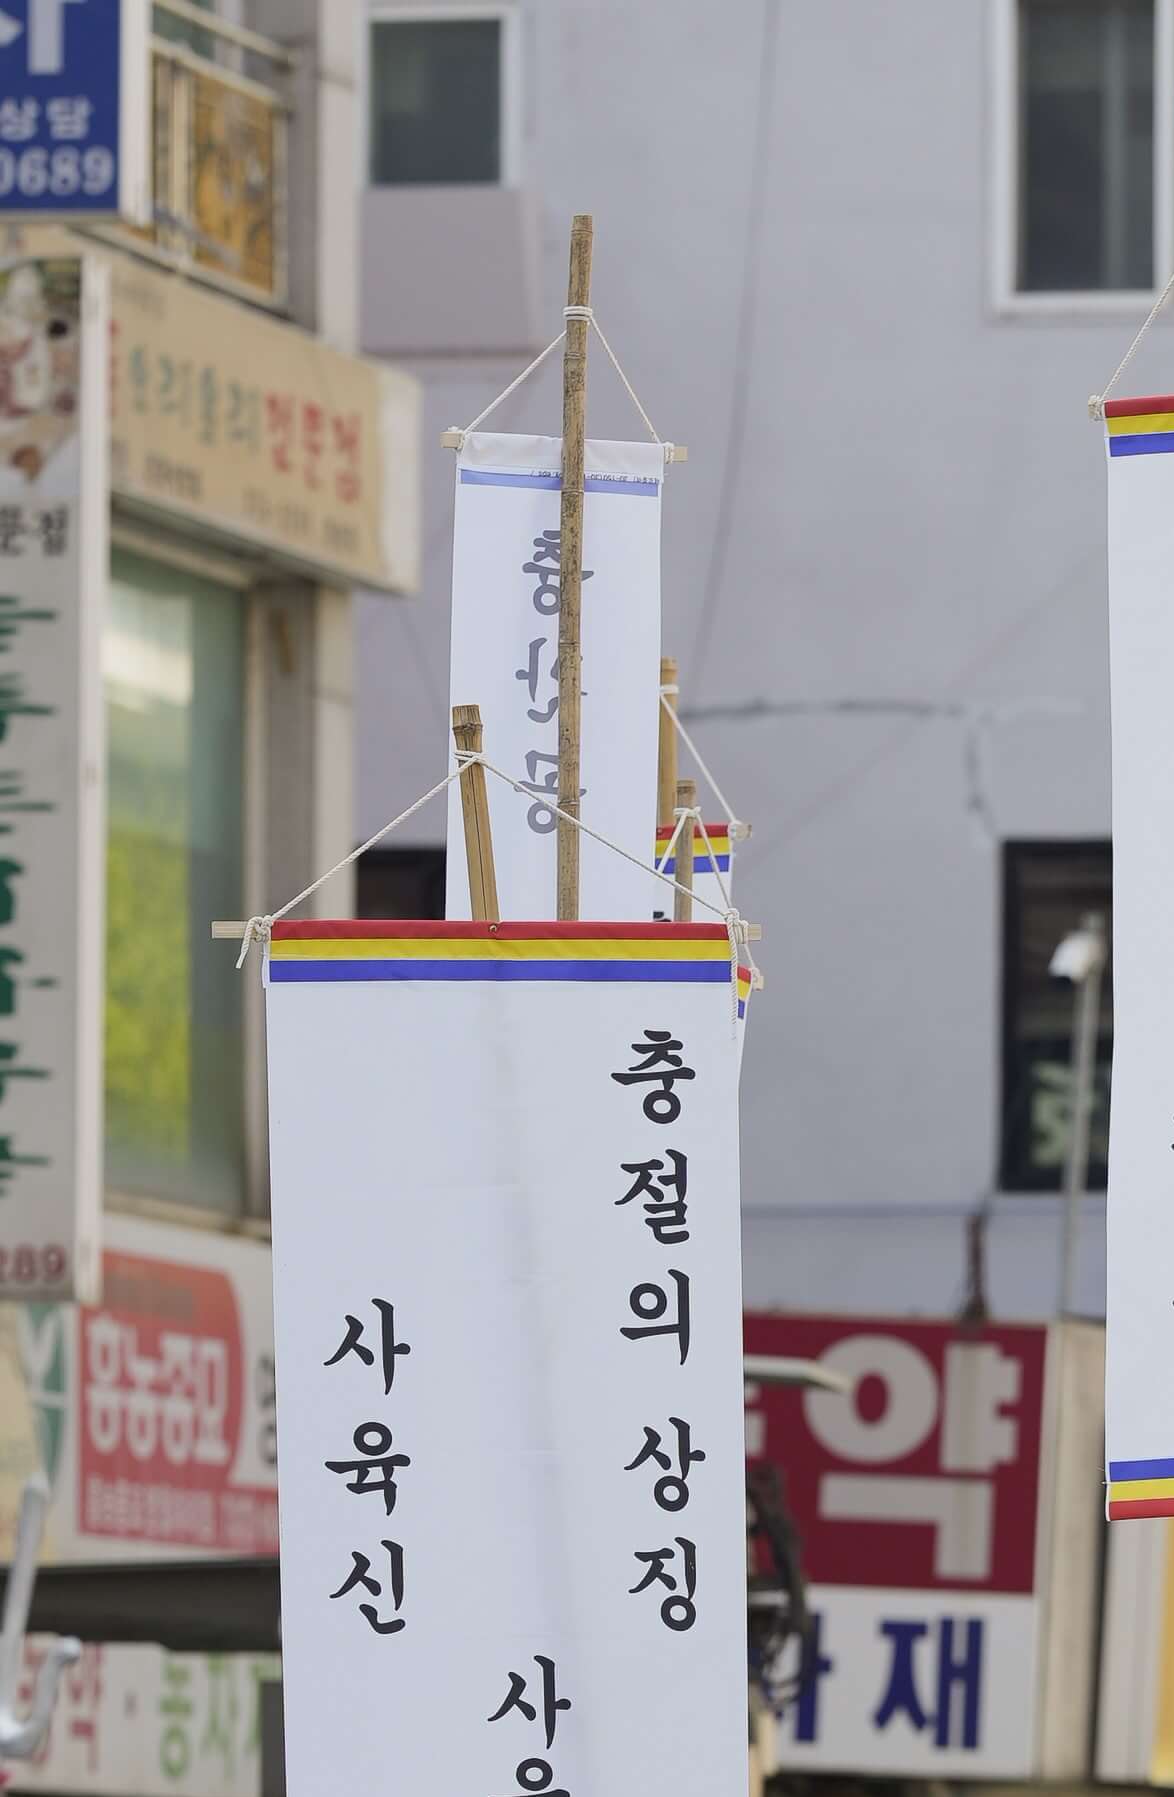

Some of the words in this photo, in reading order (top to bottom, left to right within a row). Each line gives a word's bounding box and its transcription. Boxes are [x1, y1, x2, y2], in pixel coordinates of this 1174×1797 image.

[611, 1030, 695, 1365] 충절의
[324, 1299, 410, 1634] 사육신
[624, 1417, 705, 1631] 상징
